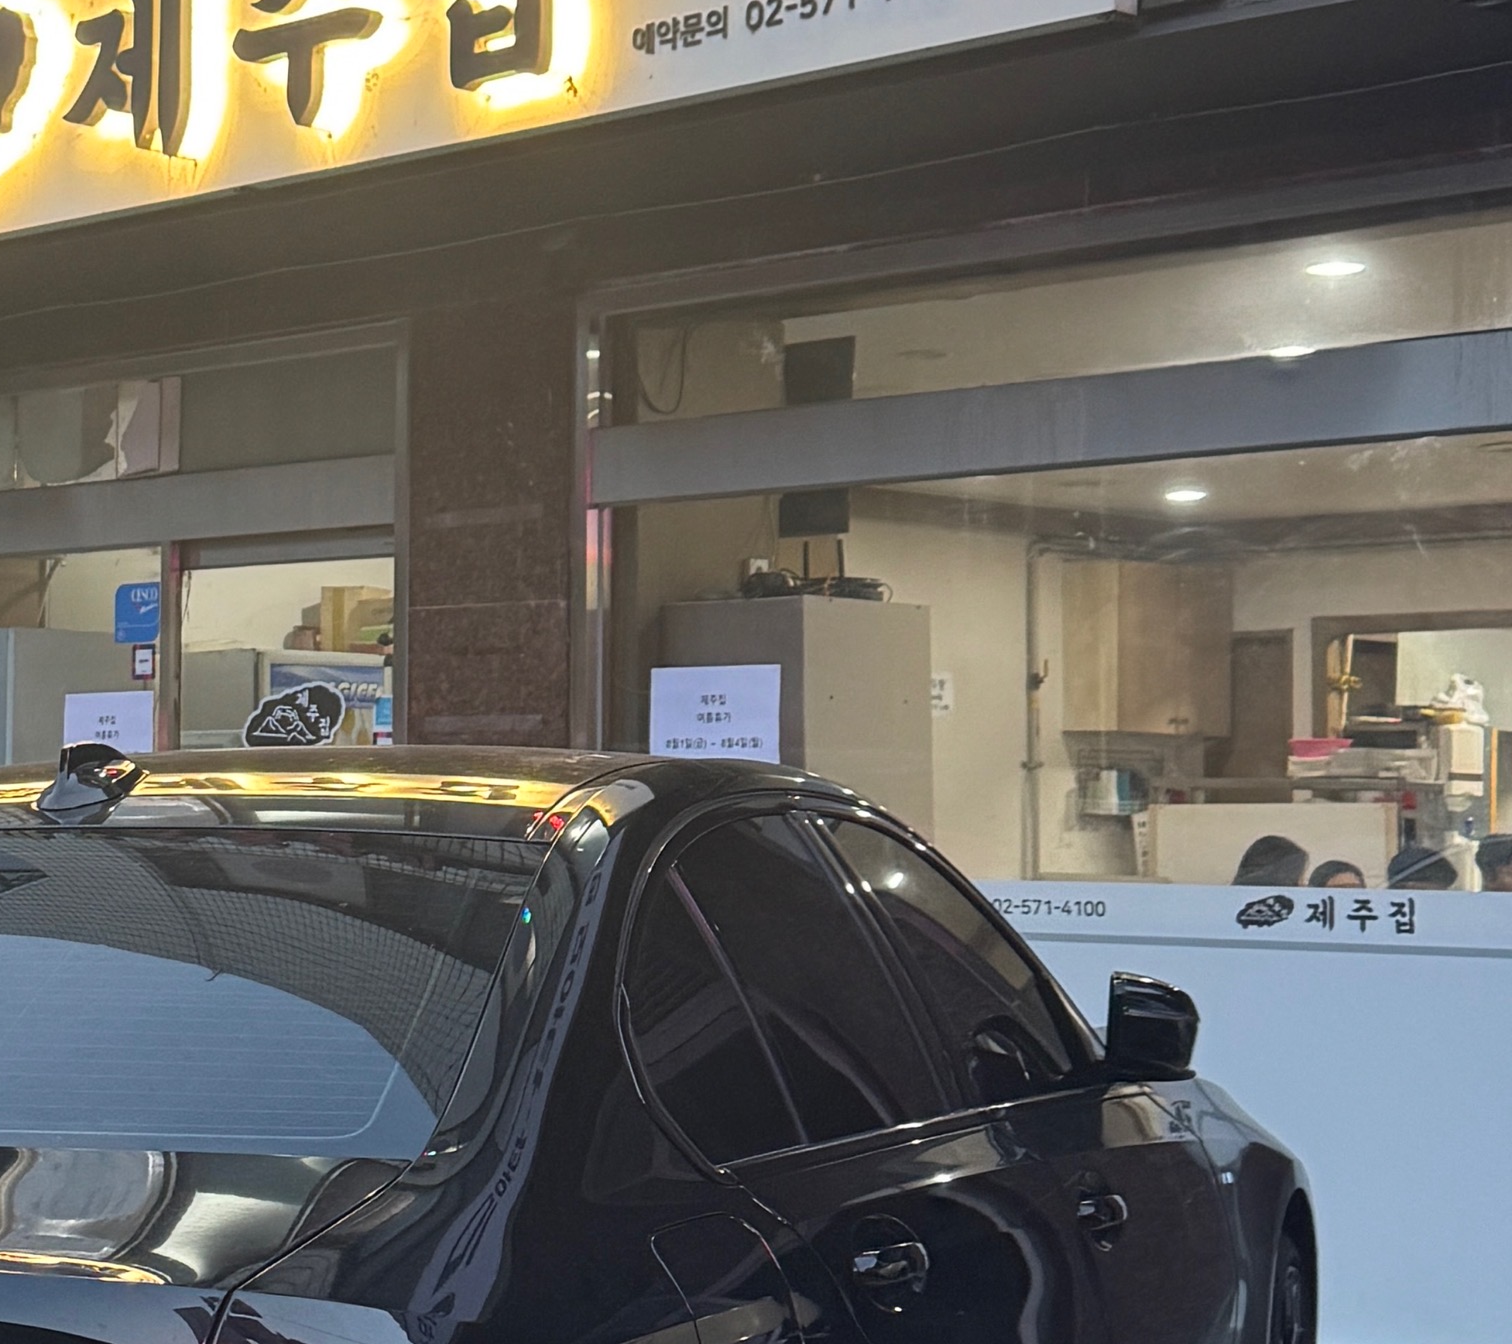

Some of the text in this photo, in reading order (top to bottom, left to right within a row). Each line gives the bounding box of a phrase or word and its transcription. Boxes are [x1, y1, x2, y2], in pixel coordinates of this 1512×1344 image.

[632, 5, 729, 55] 예약문의
[295, 689, 331, 737] 제주집
[990, 897, 1107, 917] 02-571-4100
[1304, 896, 1417, 935] 제주집
